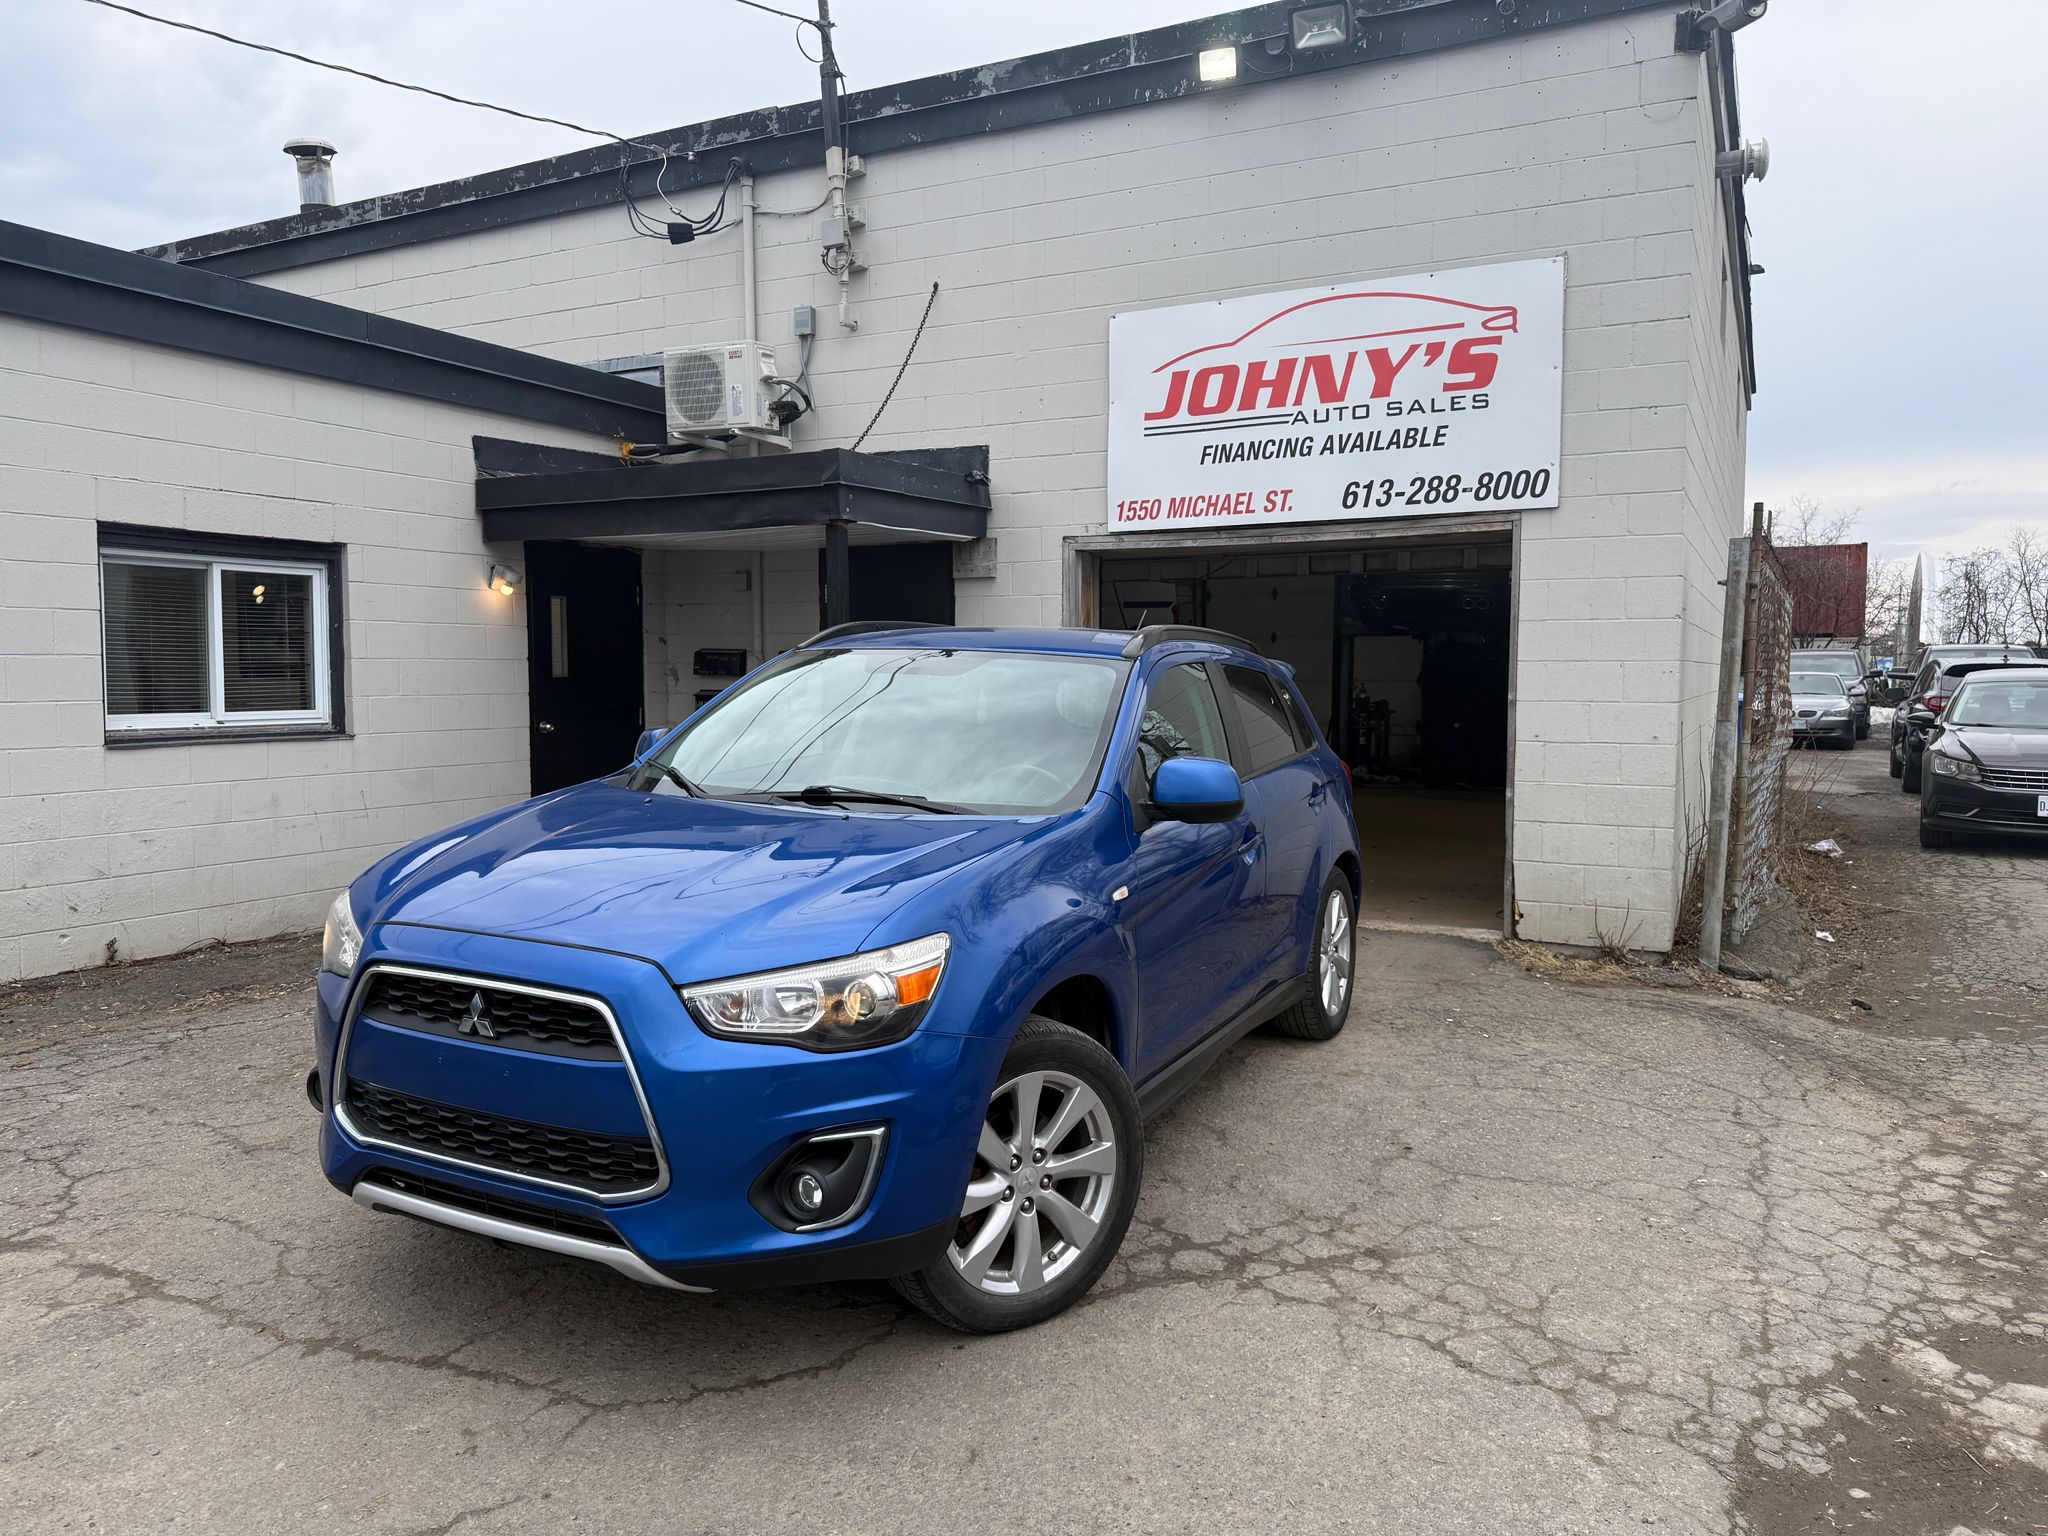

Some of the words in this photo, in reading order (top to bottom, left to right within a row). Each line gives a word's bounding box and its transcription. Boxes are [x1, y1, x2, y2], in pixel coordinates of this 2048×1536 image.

[1143, 335, 1503, 422] JOHNY'S
[1290, 403, 1371, 426] AUTO
[1385, 393, 1490, 417] SALES
[1199, 435, 1314, 466] FINANCING
[1318, 424, 1450, 456] AVAILABLE
[1116, 498, 1162, 522] 1550
[1166, 491, 1256, 519] MICHAEL
[1263, 489, 1293, 513] ST.
[1341, 468, 1551, 510] 613-288-8000
